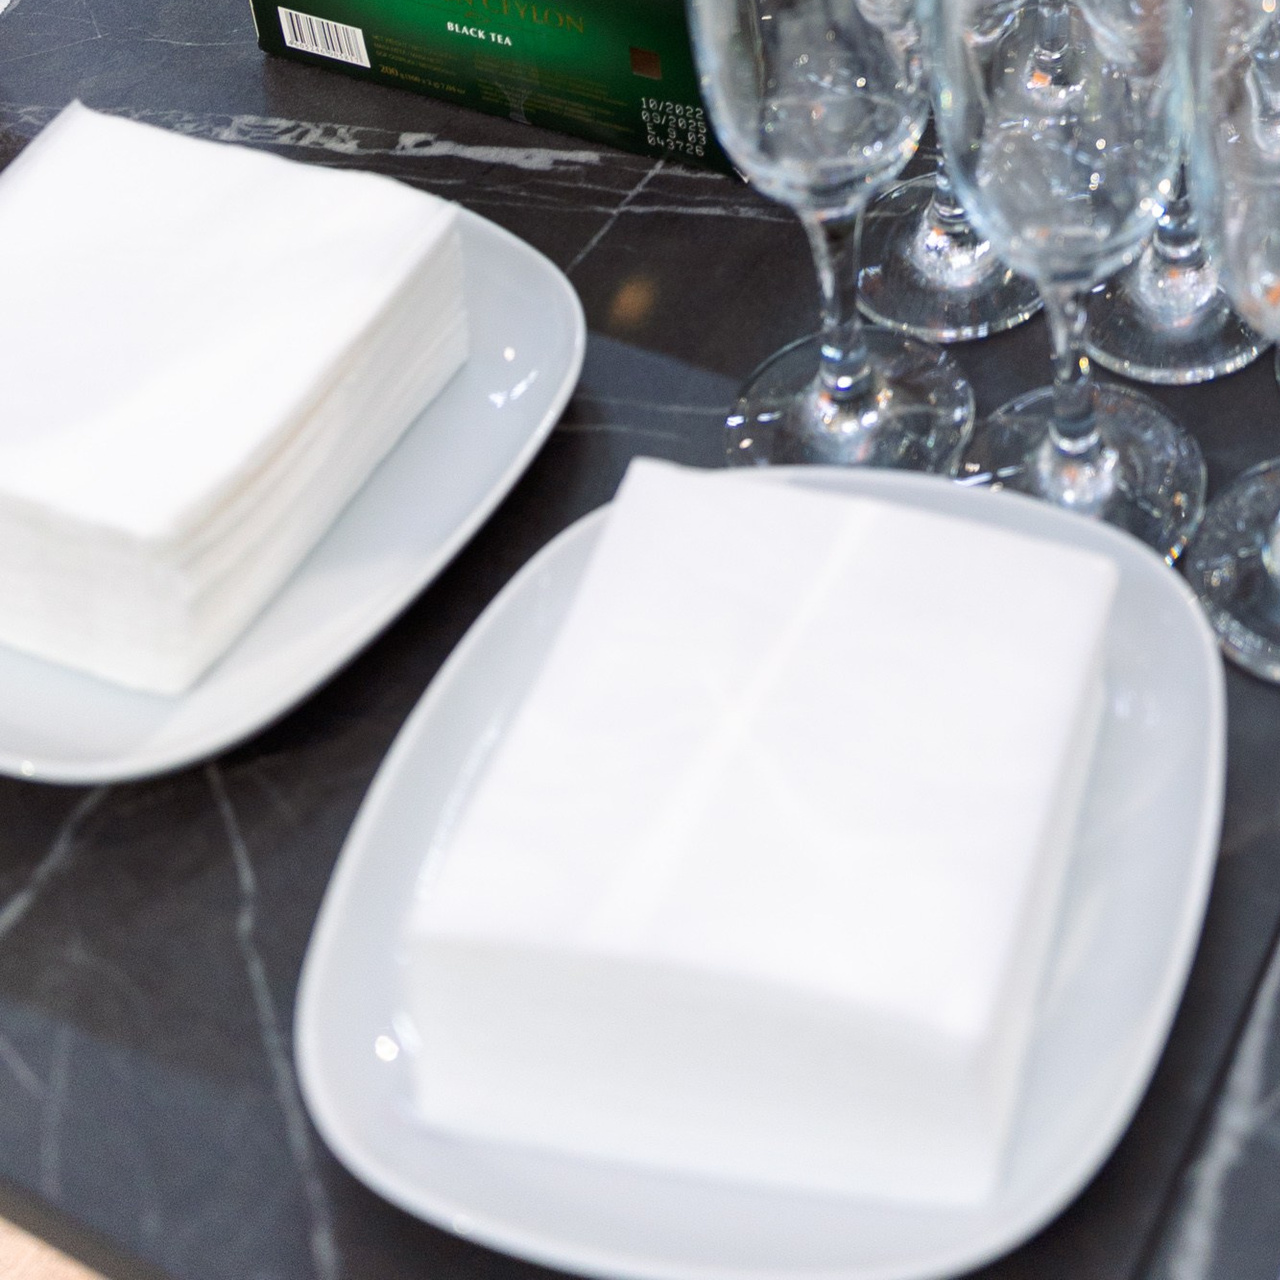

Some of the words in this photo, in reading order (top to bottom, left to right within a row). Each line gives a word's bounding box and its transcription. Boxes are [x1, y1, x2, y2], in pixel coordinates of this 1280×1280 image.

[447, 21, 486, 41] BLACK
[489, 32, 513, 46] TEA
[641, 96, 704, 119] 10/2022
